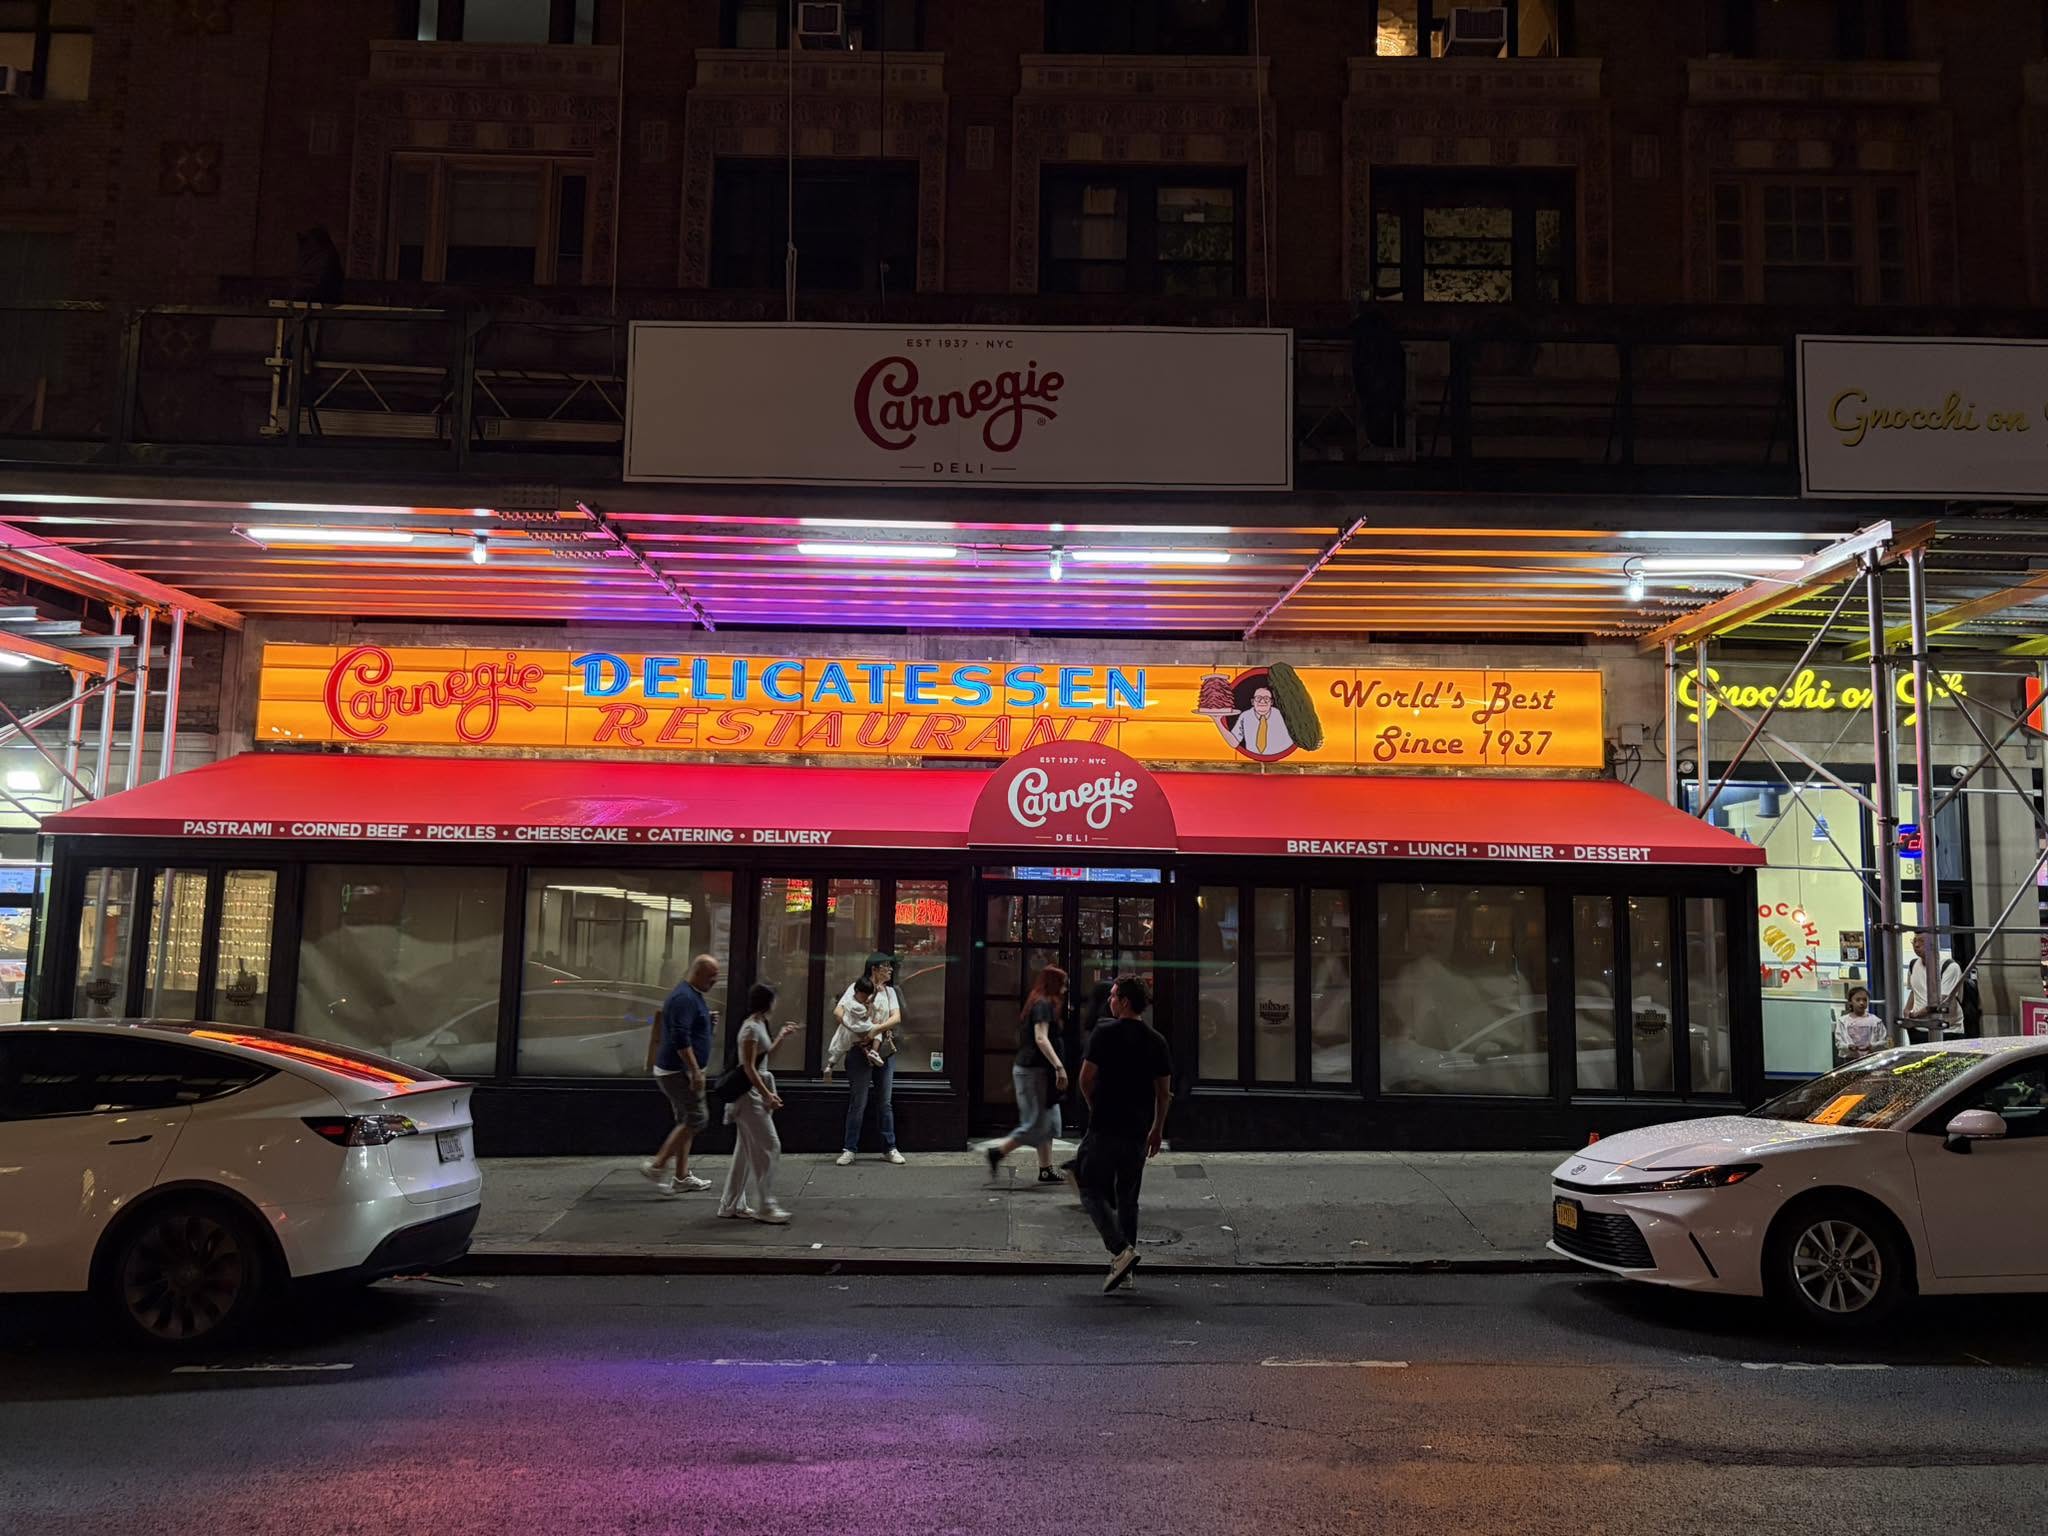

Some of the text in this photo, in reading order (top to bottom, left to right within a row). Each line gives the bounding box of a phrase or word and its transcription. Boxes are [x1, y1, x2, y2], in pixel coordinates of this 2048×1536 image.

[906, 338, 1014, 349] EST 1937 NYC
[854, 356, 1065, 453] Carnegie
[1828, 386, 1981, 448] Gnocchi
[1986, 408, 2032, 432] on
[933, 462, 984, 474] DELI
[323, 645, 544, 744] Carnegie
[570, 651, 1147, 710] DELICATESSEN
[1329, 679, 1556, 725] World's Best
[1678, 667, 1836, 723] Gnocchi
[593, 703, 1129, 751] RESTAURANT
[1373, 725, 1553, 763] Since 1937
[1040, 756, 1055, 764] EST
[1059, 757, 1078, 765] 1937
[1007, 767, 1138, 830] Carnegie
[183, 821, 832, 844] PASTRAMI CORNED BEEF PICKLES CHEESECAKE CATERING DELIVERY
[1055, 833, 1088, 843] DELI
[1287, 840, 1651, 862] BREAKFAST LUNCH DINNER DESSERT
